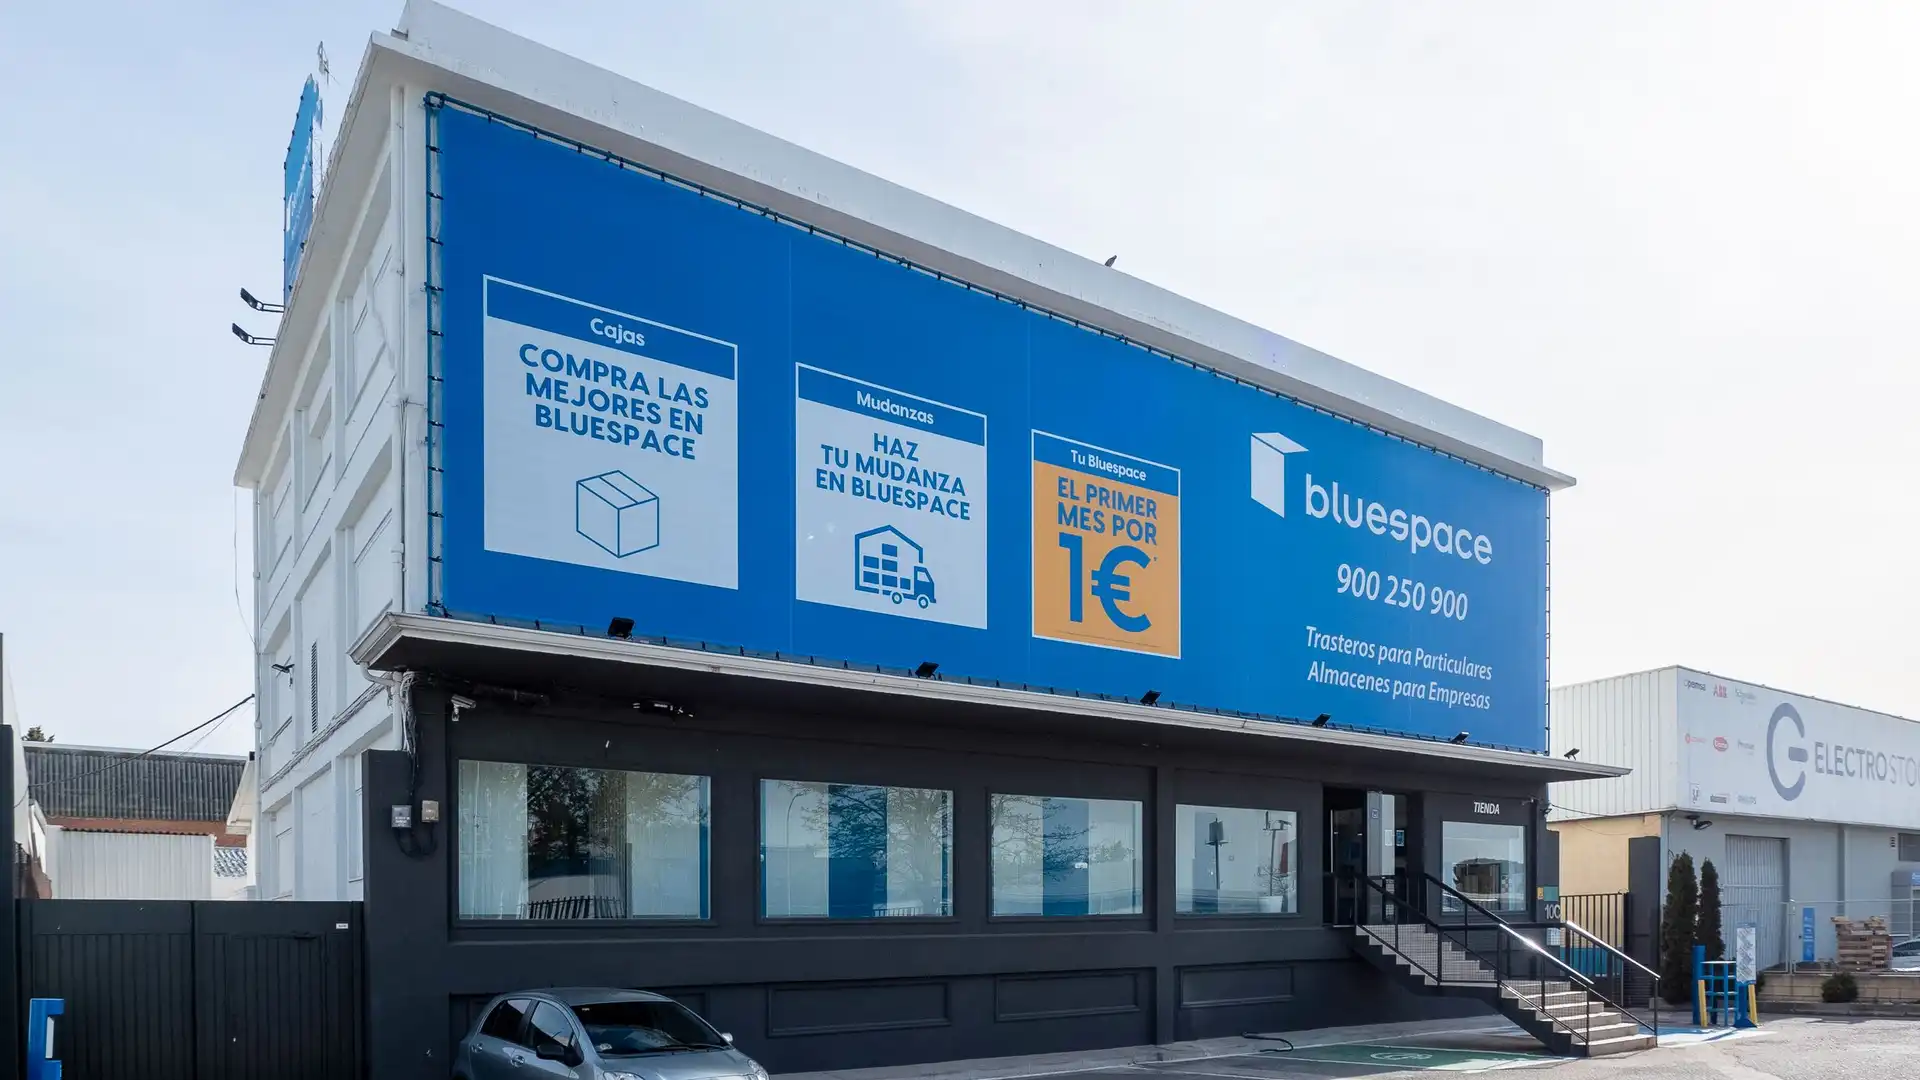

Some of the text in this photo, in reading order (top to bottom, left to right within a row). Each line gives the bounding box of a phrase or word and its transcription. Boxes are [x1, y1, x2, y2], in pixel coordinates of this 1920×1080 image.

[590, 317, 645, 347] Cajas
[519, 343, 709, 409] COMPRA LAS
[526, 372, 703, 435] MEJORES EN
[856, 390, 934, 424] Mudanzas
[535, 403, 696, 460] BLUESPACE
[873, 432, 919, 462] HAZ
[821, 443, 966, 497] TU MUDANZA
[1071, 449, 1147, 481] Tu Bluespace
[816, 467, 970, 520] EN BLUESPACE
[1057, 475, 1158, 520] EL PRIMER
[1057, 501, 1158, 546] MES POR
[1305, 473, 1493, 565] bluespace
[1337, 563, 1468, 620] 900 250 900
[1306, 625, 1492, 681] Trasteros para Particulares
[1307, 661, 1491, 710] Almacenes para Empresas
[1713, 683, 1728, 698] ABB
[1814, 741, 1920, 788] ELECTROSTO
[1473, 801, 1500, 815] TIENDA
